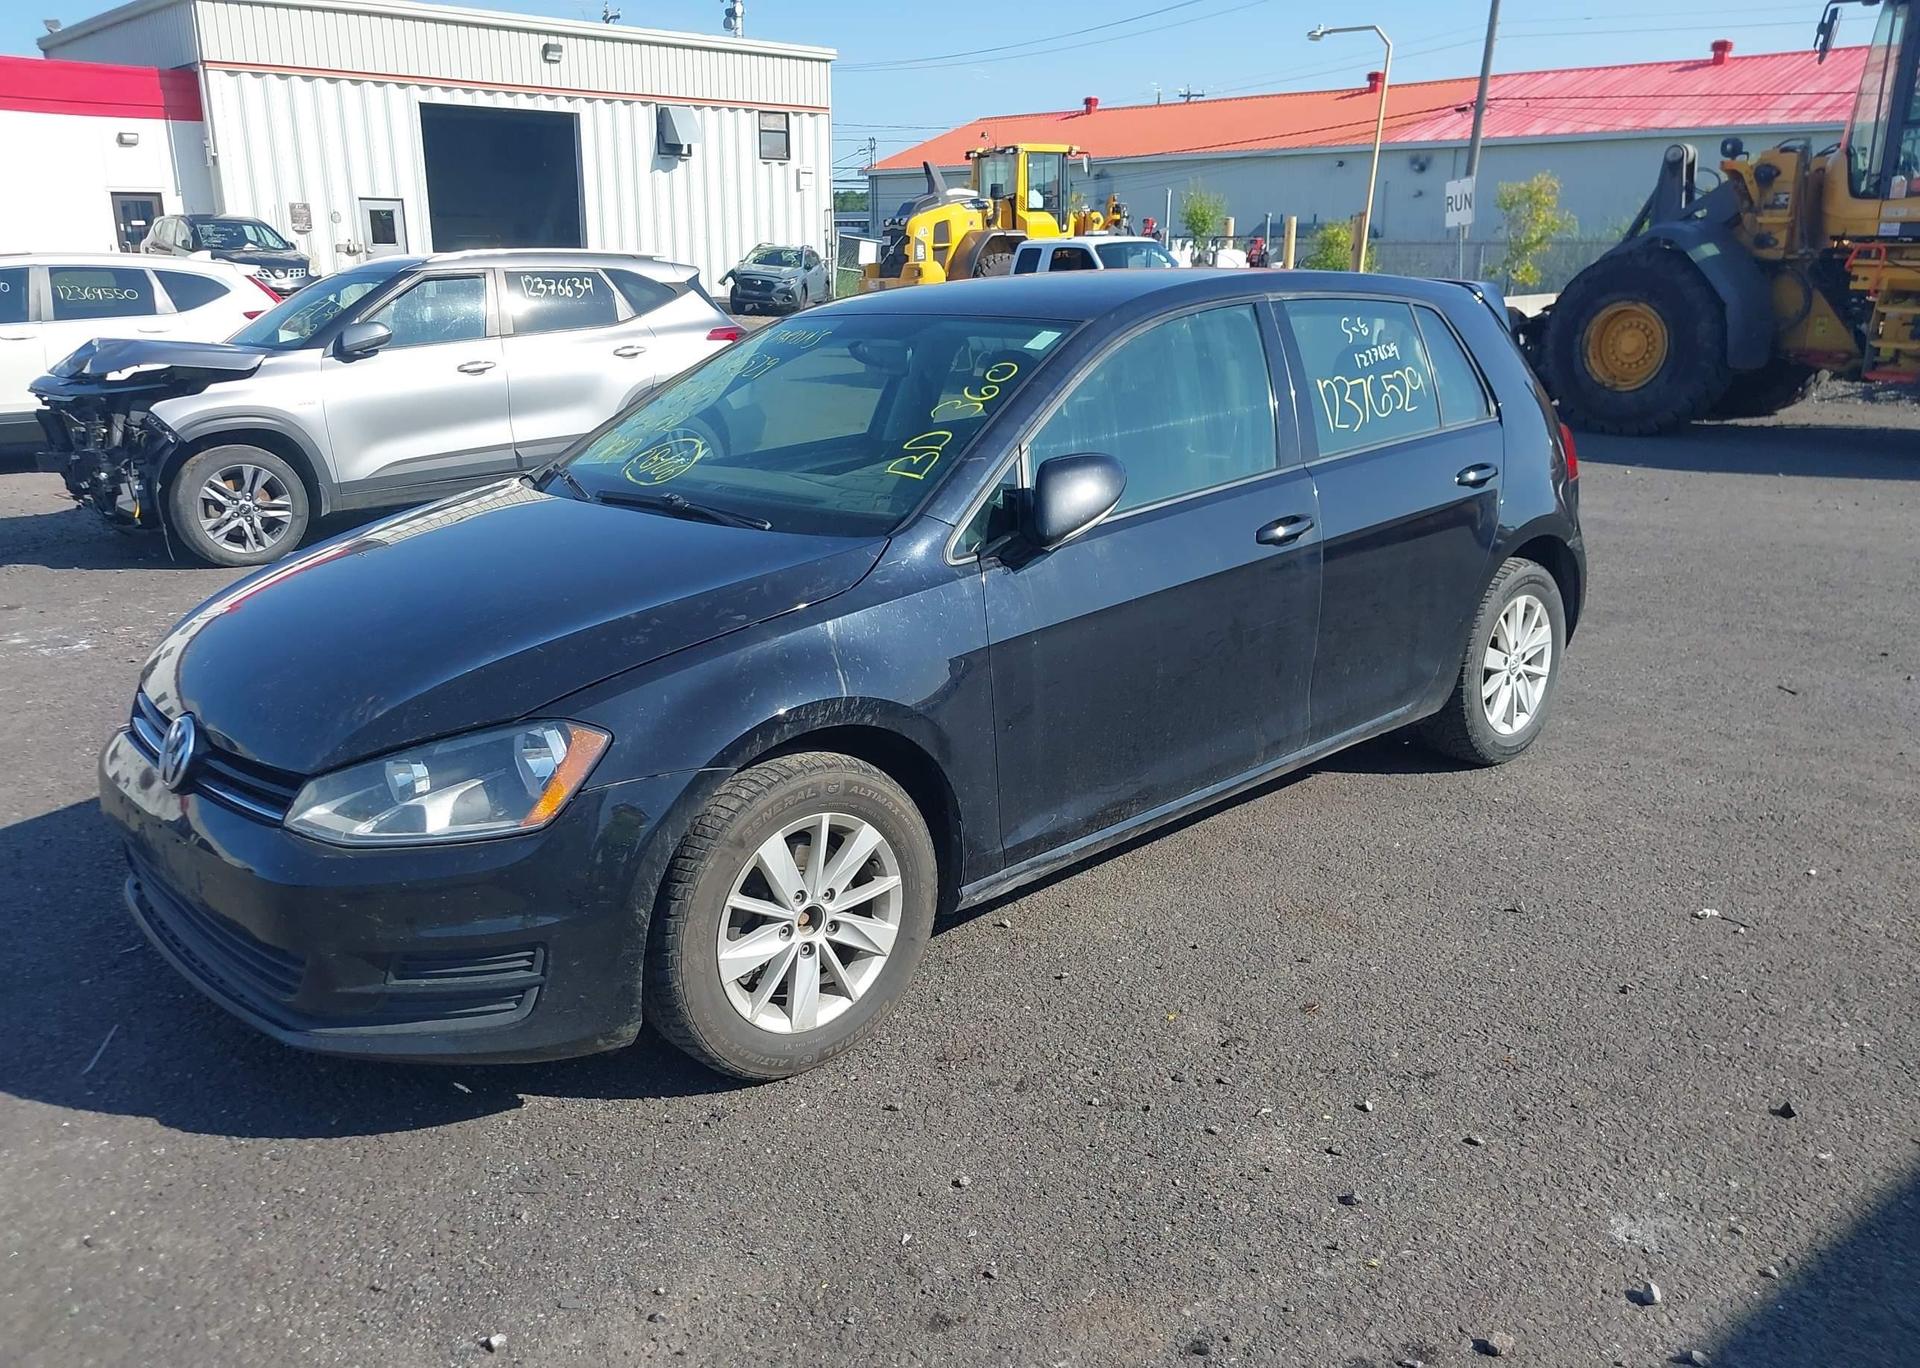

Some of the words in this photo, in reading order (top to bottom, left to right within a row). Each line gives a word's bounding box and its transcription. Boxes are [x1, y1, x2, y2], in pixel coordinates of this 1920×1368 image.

[1446, 192, 1473, 214] RUN
[520, 274, 595, 299] 12376639
[1316, 366, 1428, 434] 12376529
[742, 786, 818, 839] GENERAL
[849, 784, 901, 816] ALTIMAX
